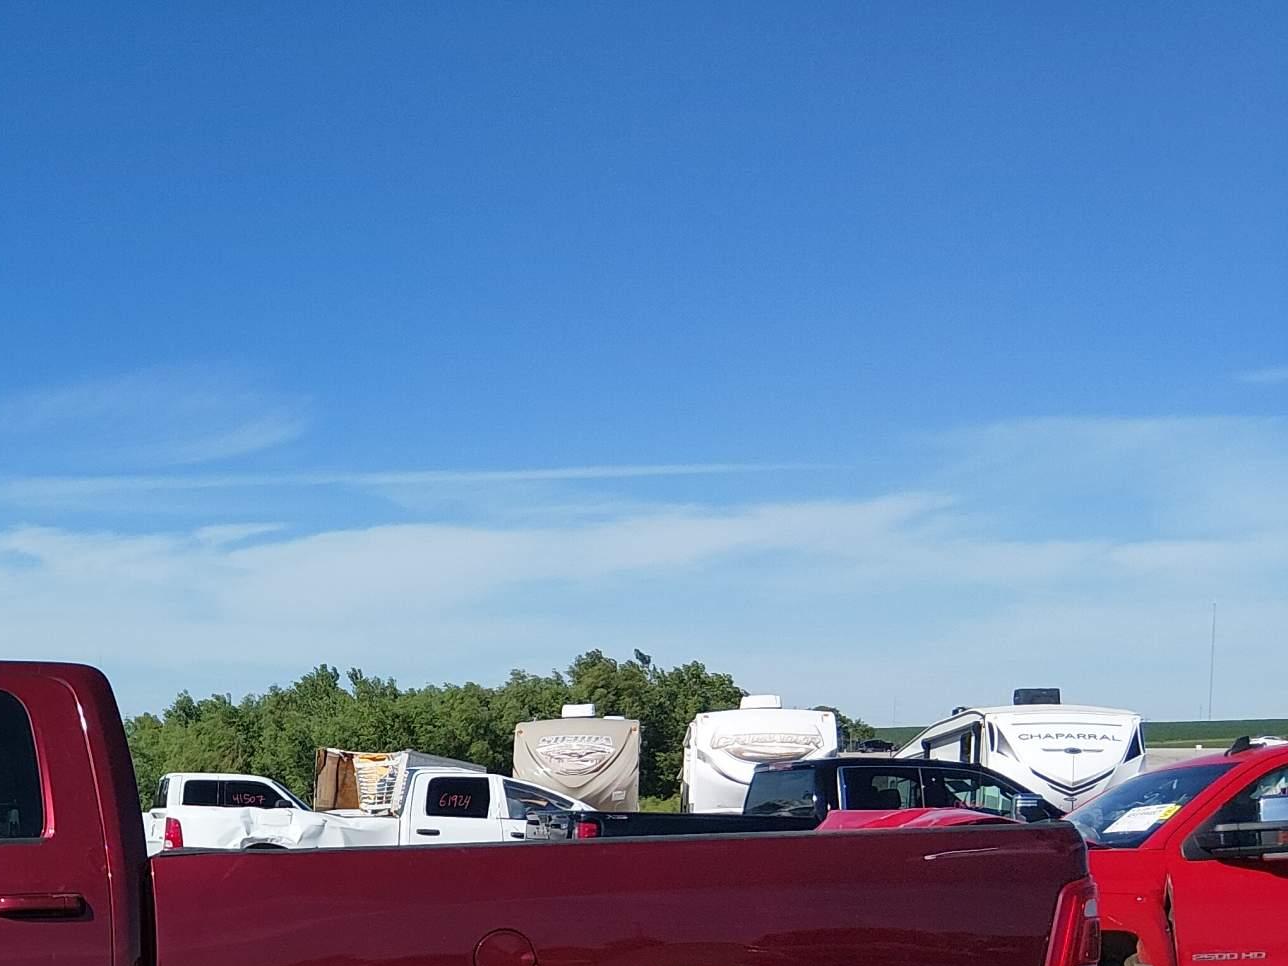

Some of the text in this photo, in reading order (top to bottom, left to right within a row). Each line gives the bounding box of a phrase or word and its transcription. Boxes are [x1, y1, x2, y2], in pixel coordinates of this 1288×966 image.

[1017, 733, 1122, 742] CHAPARRAL
[232, 793, 265, 804] 41507
[439, 793, 472, 809] 61924
[1192, 951, 1266, 961] 2500 HD
